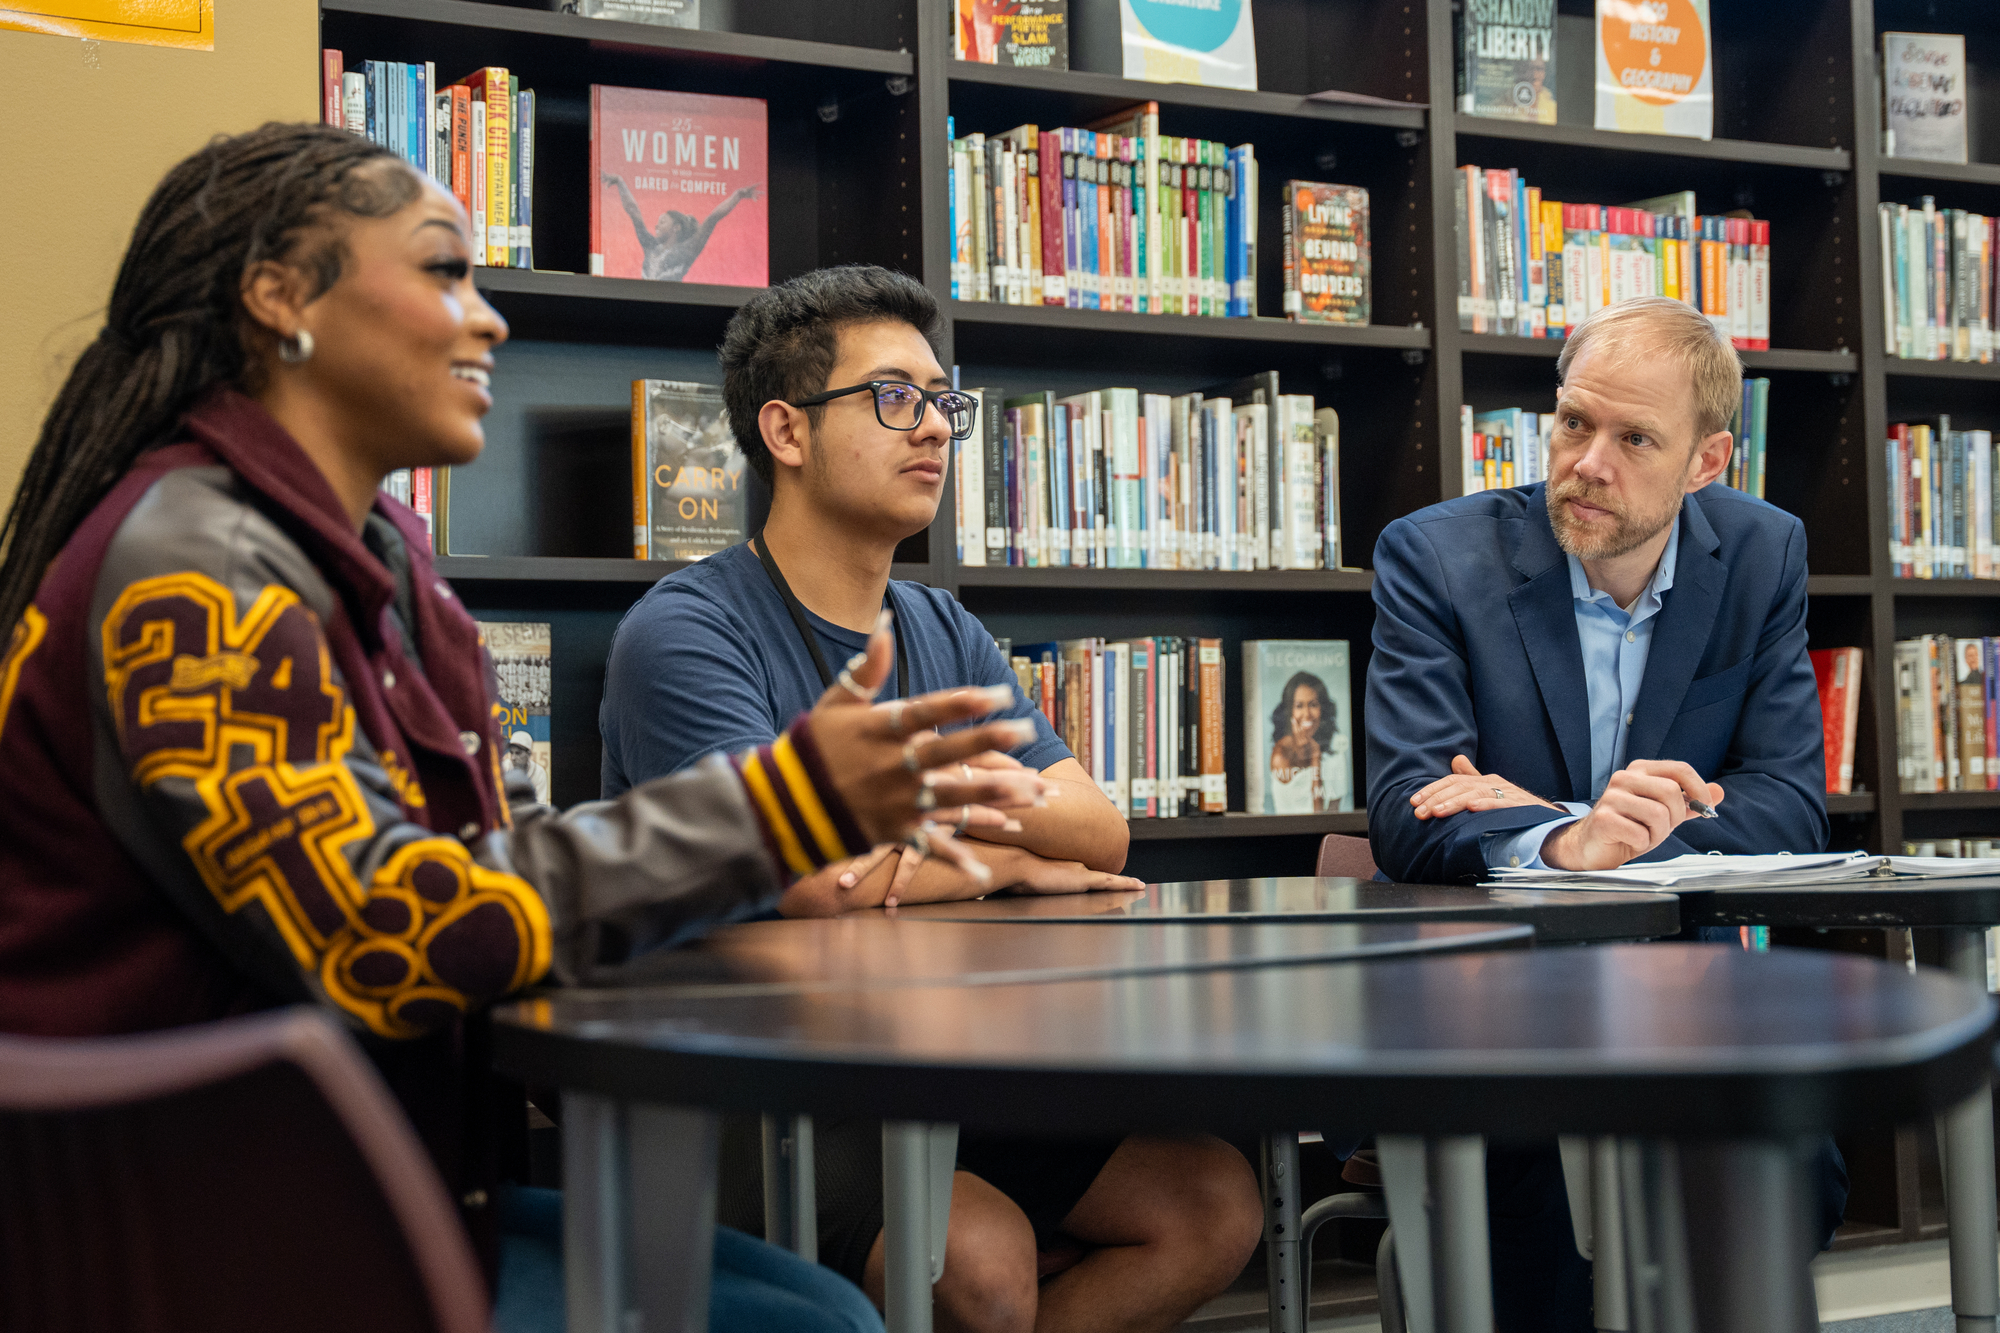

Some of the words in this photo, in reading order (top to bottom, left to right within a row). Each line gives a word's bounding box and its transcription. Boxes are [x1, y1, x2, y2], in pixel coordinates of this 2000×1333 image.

[992, 13, 1064, 25] PERFORMANCE
[1476, 0, 1553, 28] SHADOW
[1476, 24, 1552, 62] LIBERTY
[1629, 22, 1681, 45] HISTORY
[1012, 54, 1050, 67] WORD
[1018, 46, 1056, 55] SPOKEN
[1649, 47, 1662, 67] &
[1621, 67, 1693, 91] GEOGRAPHY
[458, 97, 467, 114] THE
[488, 80, 509, 121] MUCK
[458, 119, 468, 153] PUNCH
[671, 118, 693, 131] 25
[488, 127, 509, 160] CITY
[621, 128, 740, 171] WOMEN
[493, 162, 504, 197] BRYAN
[634, 175, 669, 191] DARED
[680, 179, 727, 196] COMPETE
[1307, 203, 1353, 227] LIVING
[1304, 238, 1358, 262] BEYOND
[1707, 244, 1715, 264] NEW
[1301, 273, 1363, 297] BORDERS
[1573, 250, 1584, 302] England
[1633, 255, 1644, 295] Spain
[1756, 264, 1765, 305] Japan
[1707, 265, 1716, 312] ENGLAND
[654, 464, 742, 491] CARRY
[678, 496, 719, 520] ON
[1266, 651, 1346, 668] BECOMING
[101, 570, 356, 785] 24
